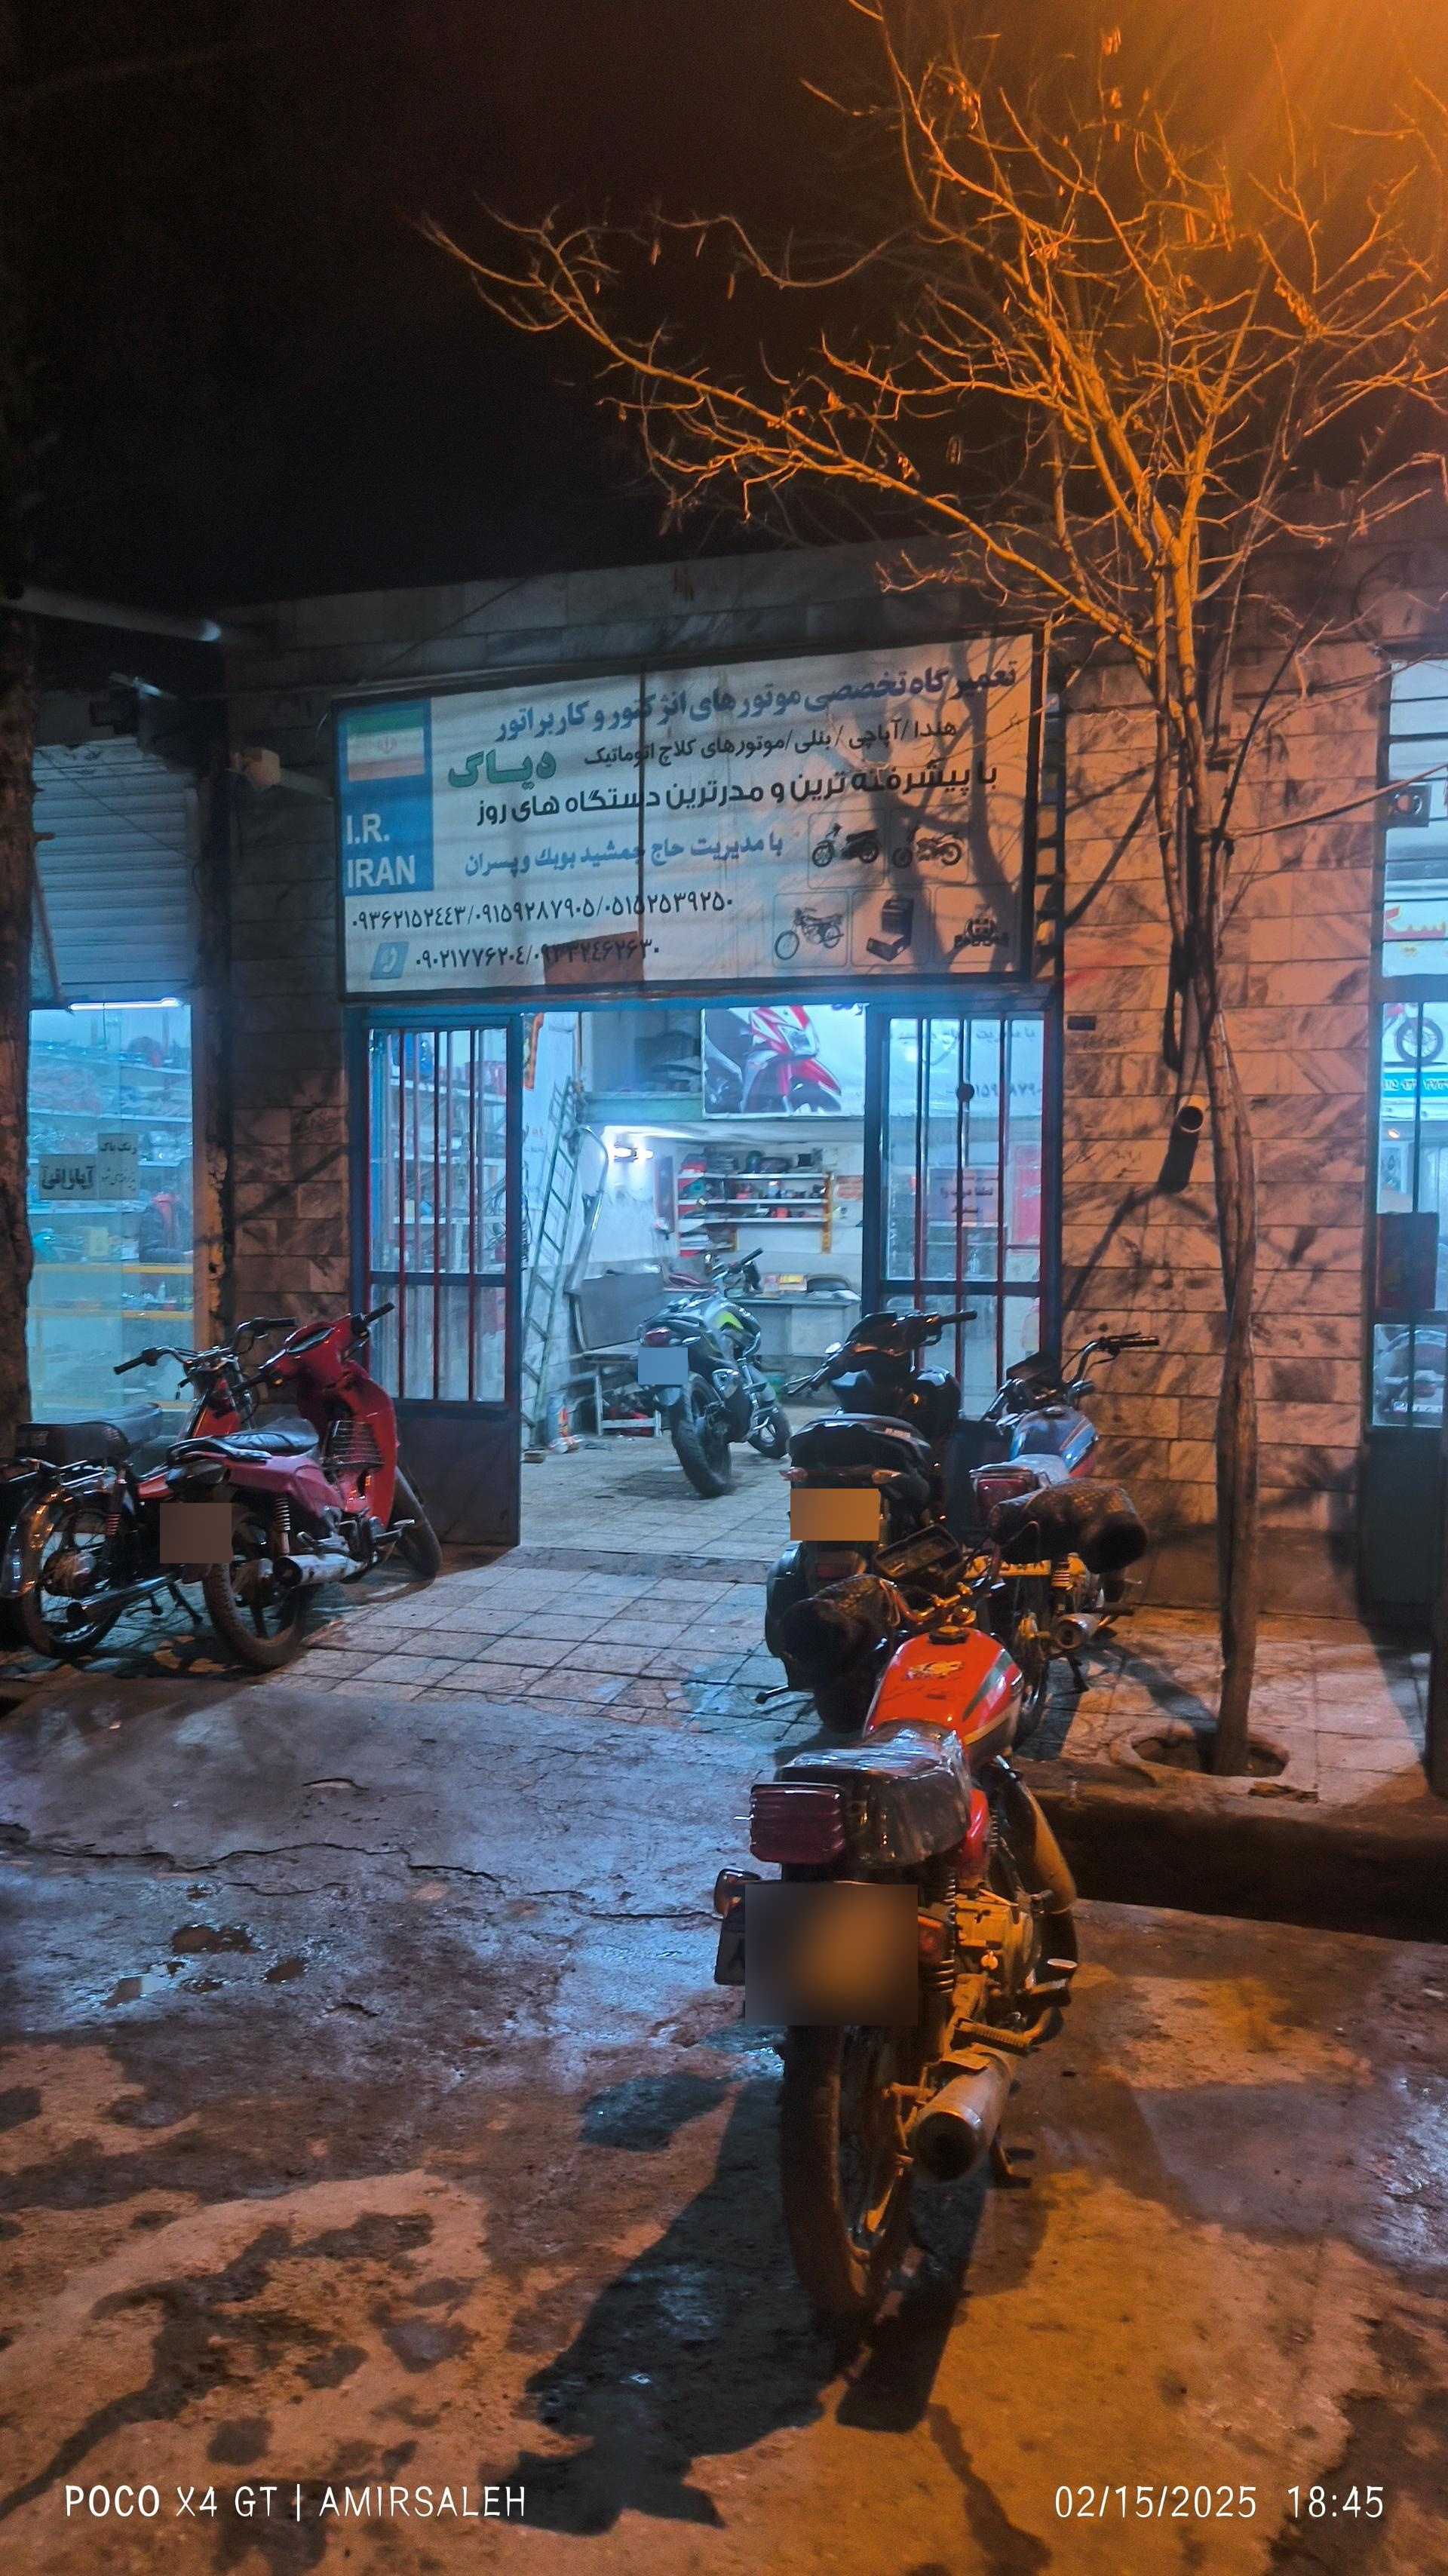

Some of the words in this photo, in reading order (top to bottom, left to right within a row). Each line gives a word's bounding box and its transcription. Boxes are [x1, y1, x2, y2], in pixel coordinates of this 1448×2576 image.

[804, 670, 907, 712] تخصصی
[494, 699, 591, 743] کاربراتور
[584, 742, 655, 768] اتوماتیک
[658, 738, 697, 766] کلاچ
[771, 781, 785, 805] و
[477, 799, 508, 826] روز
[346, 813, 390, 845] I.R.
[580, 839, 646, 866] جمشید
[651, 837, 685, 866] حاج
[690, 836, 765, 861] مدیریت
[768, 830, 784, 857] با
[346, 854, 416, 889] IRAN
